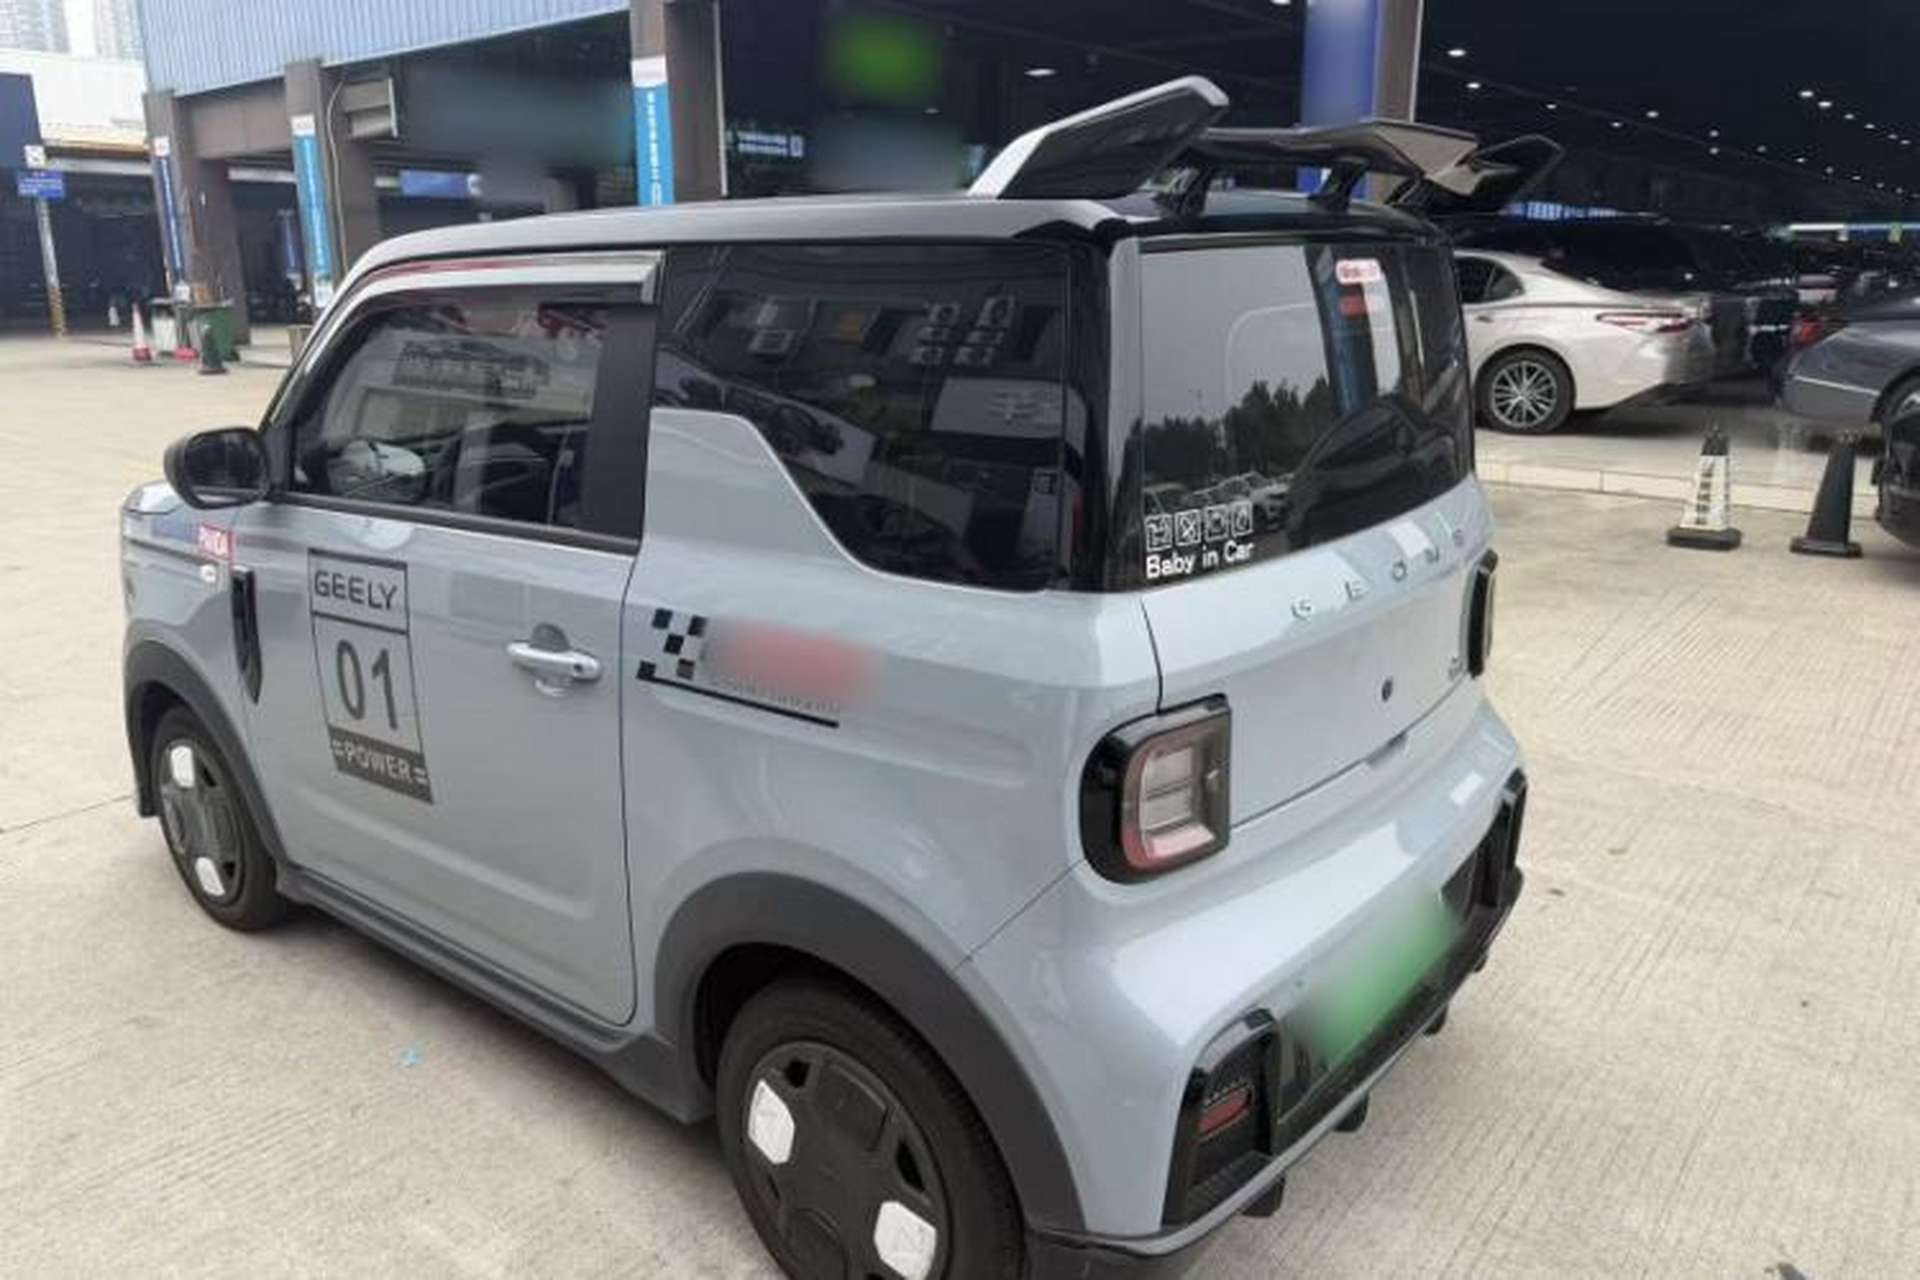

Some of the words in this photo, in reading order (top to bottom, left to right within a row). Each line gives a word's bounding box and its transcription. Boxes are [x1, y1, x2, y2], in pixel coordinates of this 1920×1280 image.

[1146, 550, 1197, 579] Baby
[1202, 544, 1219, 569] in
[1223, 540, 1255, 563] Car
[314, 569, 398, 611] GEELY
[335, 639, 399, 731] 01
